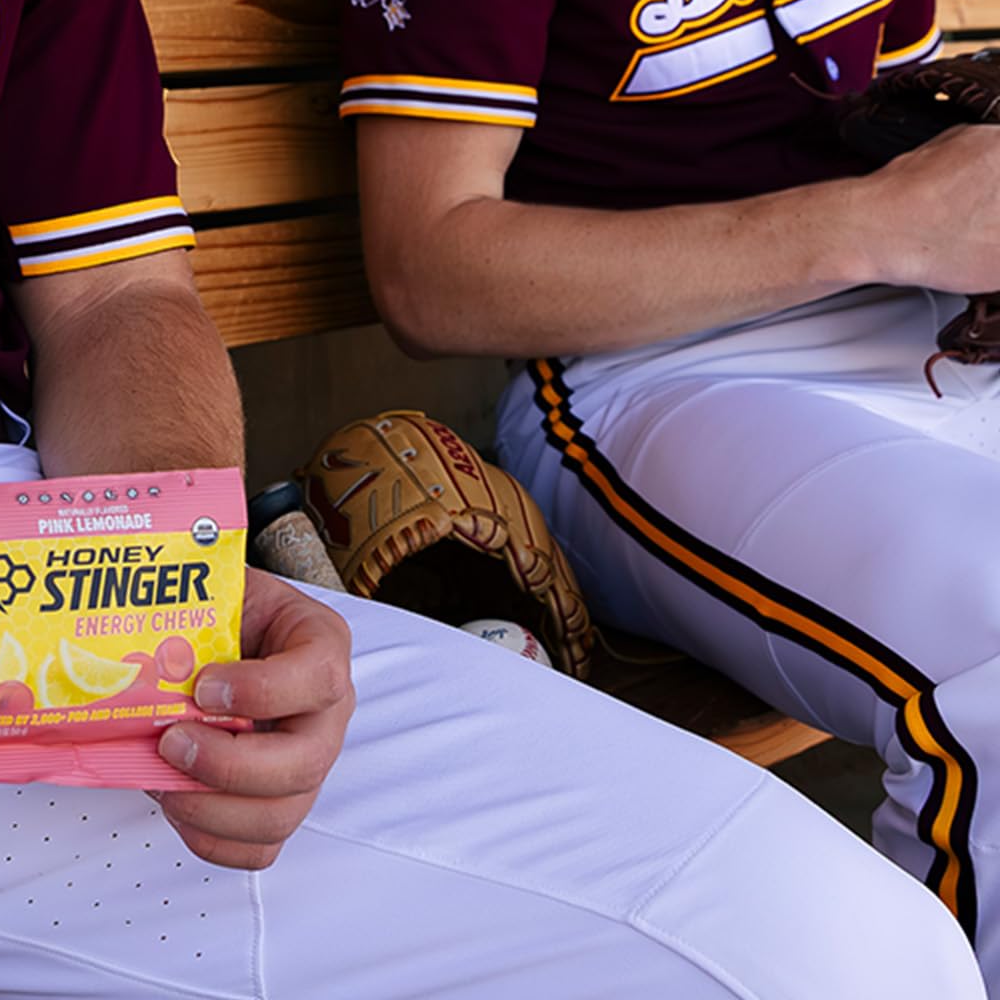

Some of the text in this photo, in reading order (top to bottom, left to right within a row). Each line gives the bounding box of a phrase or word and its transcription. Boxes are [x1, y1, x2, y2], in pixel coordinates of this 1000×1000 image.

[38, 513, 153, 534] PINK LEMONADE
[46, 545, 164, 567] HONEY
[39, 561, 212, 613] STINGER
[75, 606, 217, 637] ENERGY CHEWS
